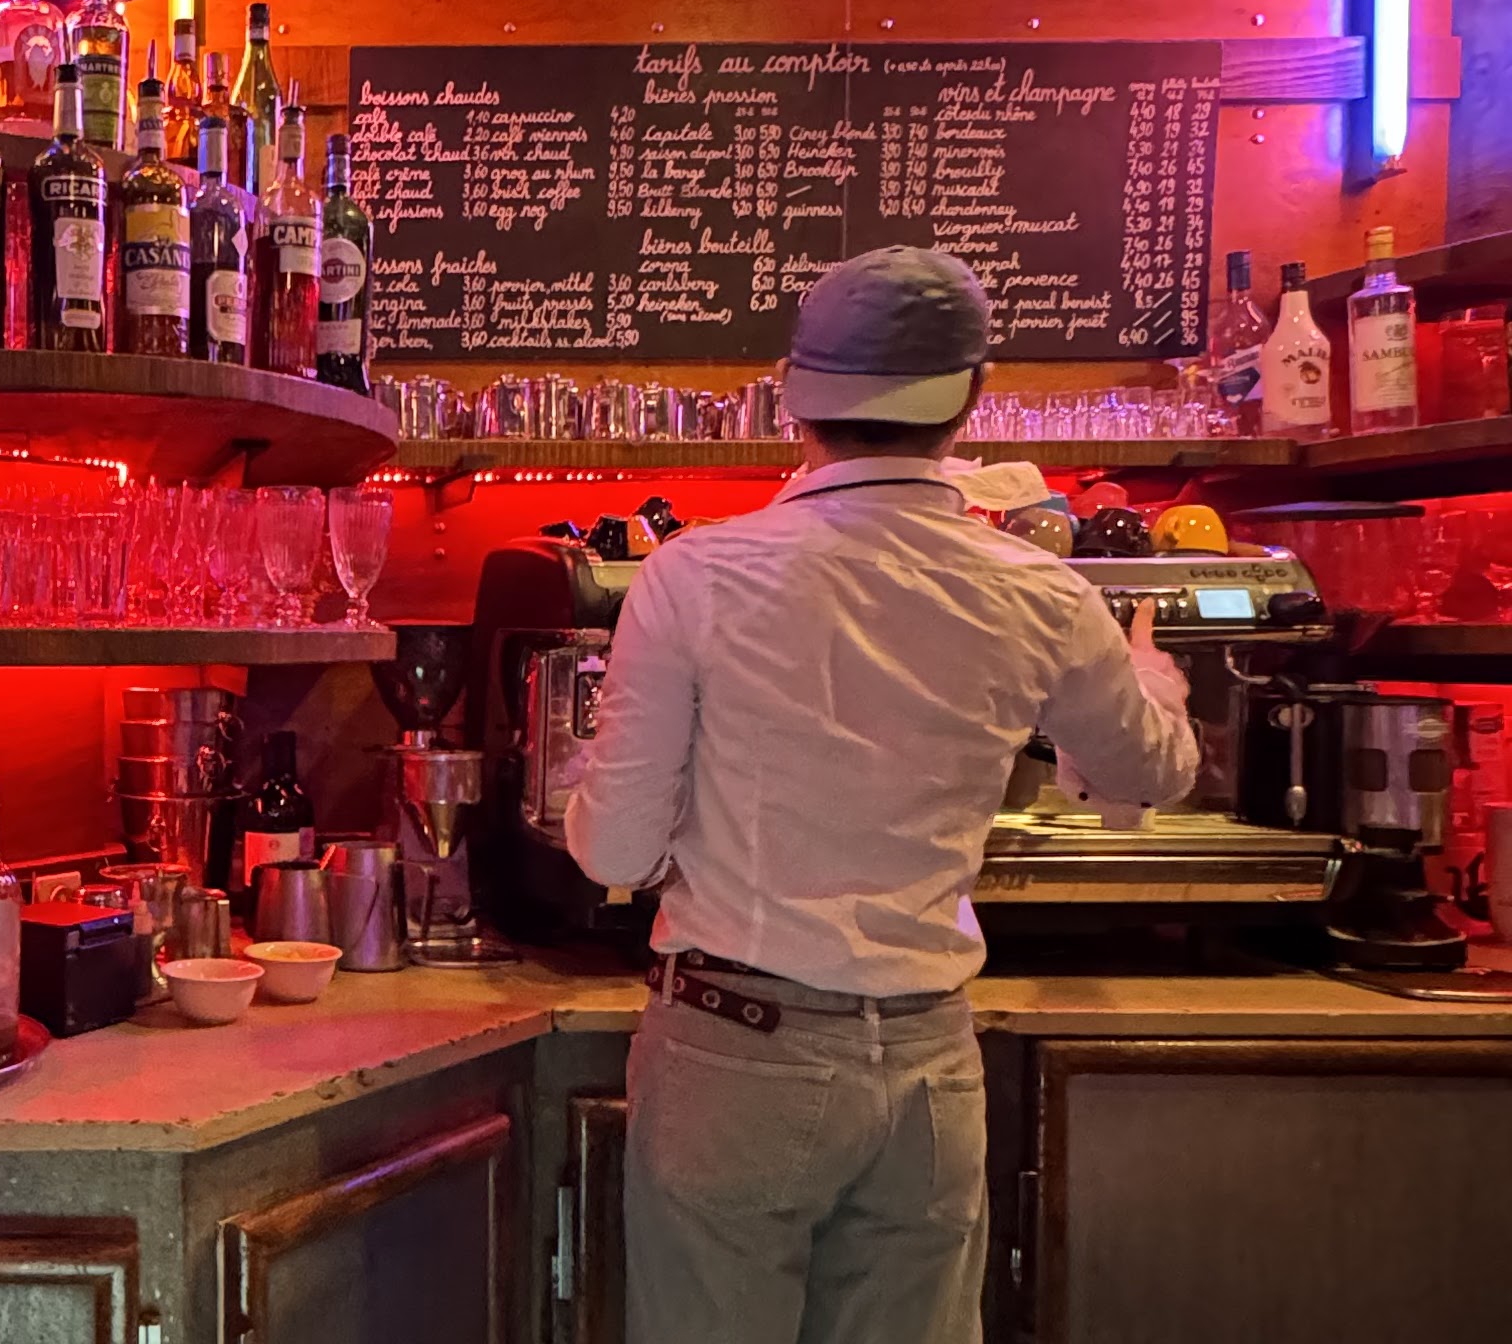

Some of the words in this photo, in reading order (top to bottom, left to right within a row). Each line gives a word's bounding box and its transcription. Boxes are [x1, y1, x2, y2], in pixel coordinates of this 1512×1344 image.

[633, 43, 703, 91] tarifs
[718, 55, 755, 74] au
[761, 43, 871, 92] comptoir
[360, 80, 430, 106] boissons
[434, 81, 500, 106] chaudes
[642, 78, 696, 104] bières
[702, 88, 778, 116] pression
[938, 81, 980, 102] vins
[984, 73, 1007, 102] et
[1008, 68, 1117, 116] champagne
[353, 107, 388, 132] café
[491, 109, 576, 132] cappuccino
[935, 121, 1007, 139] bordeaux
[351, 122, 403, 143] double
[407, 122, 437, 154] café
[491, 125, 525, 151] café
[529, 126, 588, 143] viennois
[641, 121, 714, 148] Capitale
[790, 125, 828, 147] Ciney
[352, 144, 417, 161] chocolat
[424, 141, 472, 162] chaud
[523, 143, 571, 161] chaud
[787, 142, 857, 159] Heineken
[352, 162, 381, 190] café
[490, 168, 529, 190] grog
[531, 170, 552, 180] au
[554, 160, 596, 180] rhum
[641, 162, 658, 178] la
[663, 160, 706, 186] barge
[783, 159, 859, 186] Brooklyn
[385, 180, 434, 200] chaud
[536, 180, 581, 210] coffee
[376, 200, 444, 234] infusions
[489, 205, 517, 231] egg
[519, 205, 548, 231] nog
[781, 203, 843, 230] guinness
[638, 228, 692, 255] bières
[697, 226, 776, 254] bouteille
[321, 264, 360, 277] ARTINI
[638, 260, 692, 273] corona
[386, 274, 420, 293] cola
[638, 273, 719, 299] carlsberg
[1002, 274, 1079, 295] provence
[396, 309, 462, 330] limonade
[486, 329, 552, 348] cocktails
